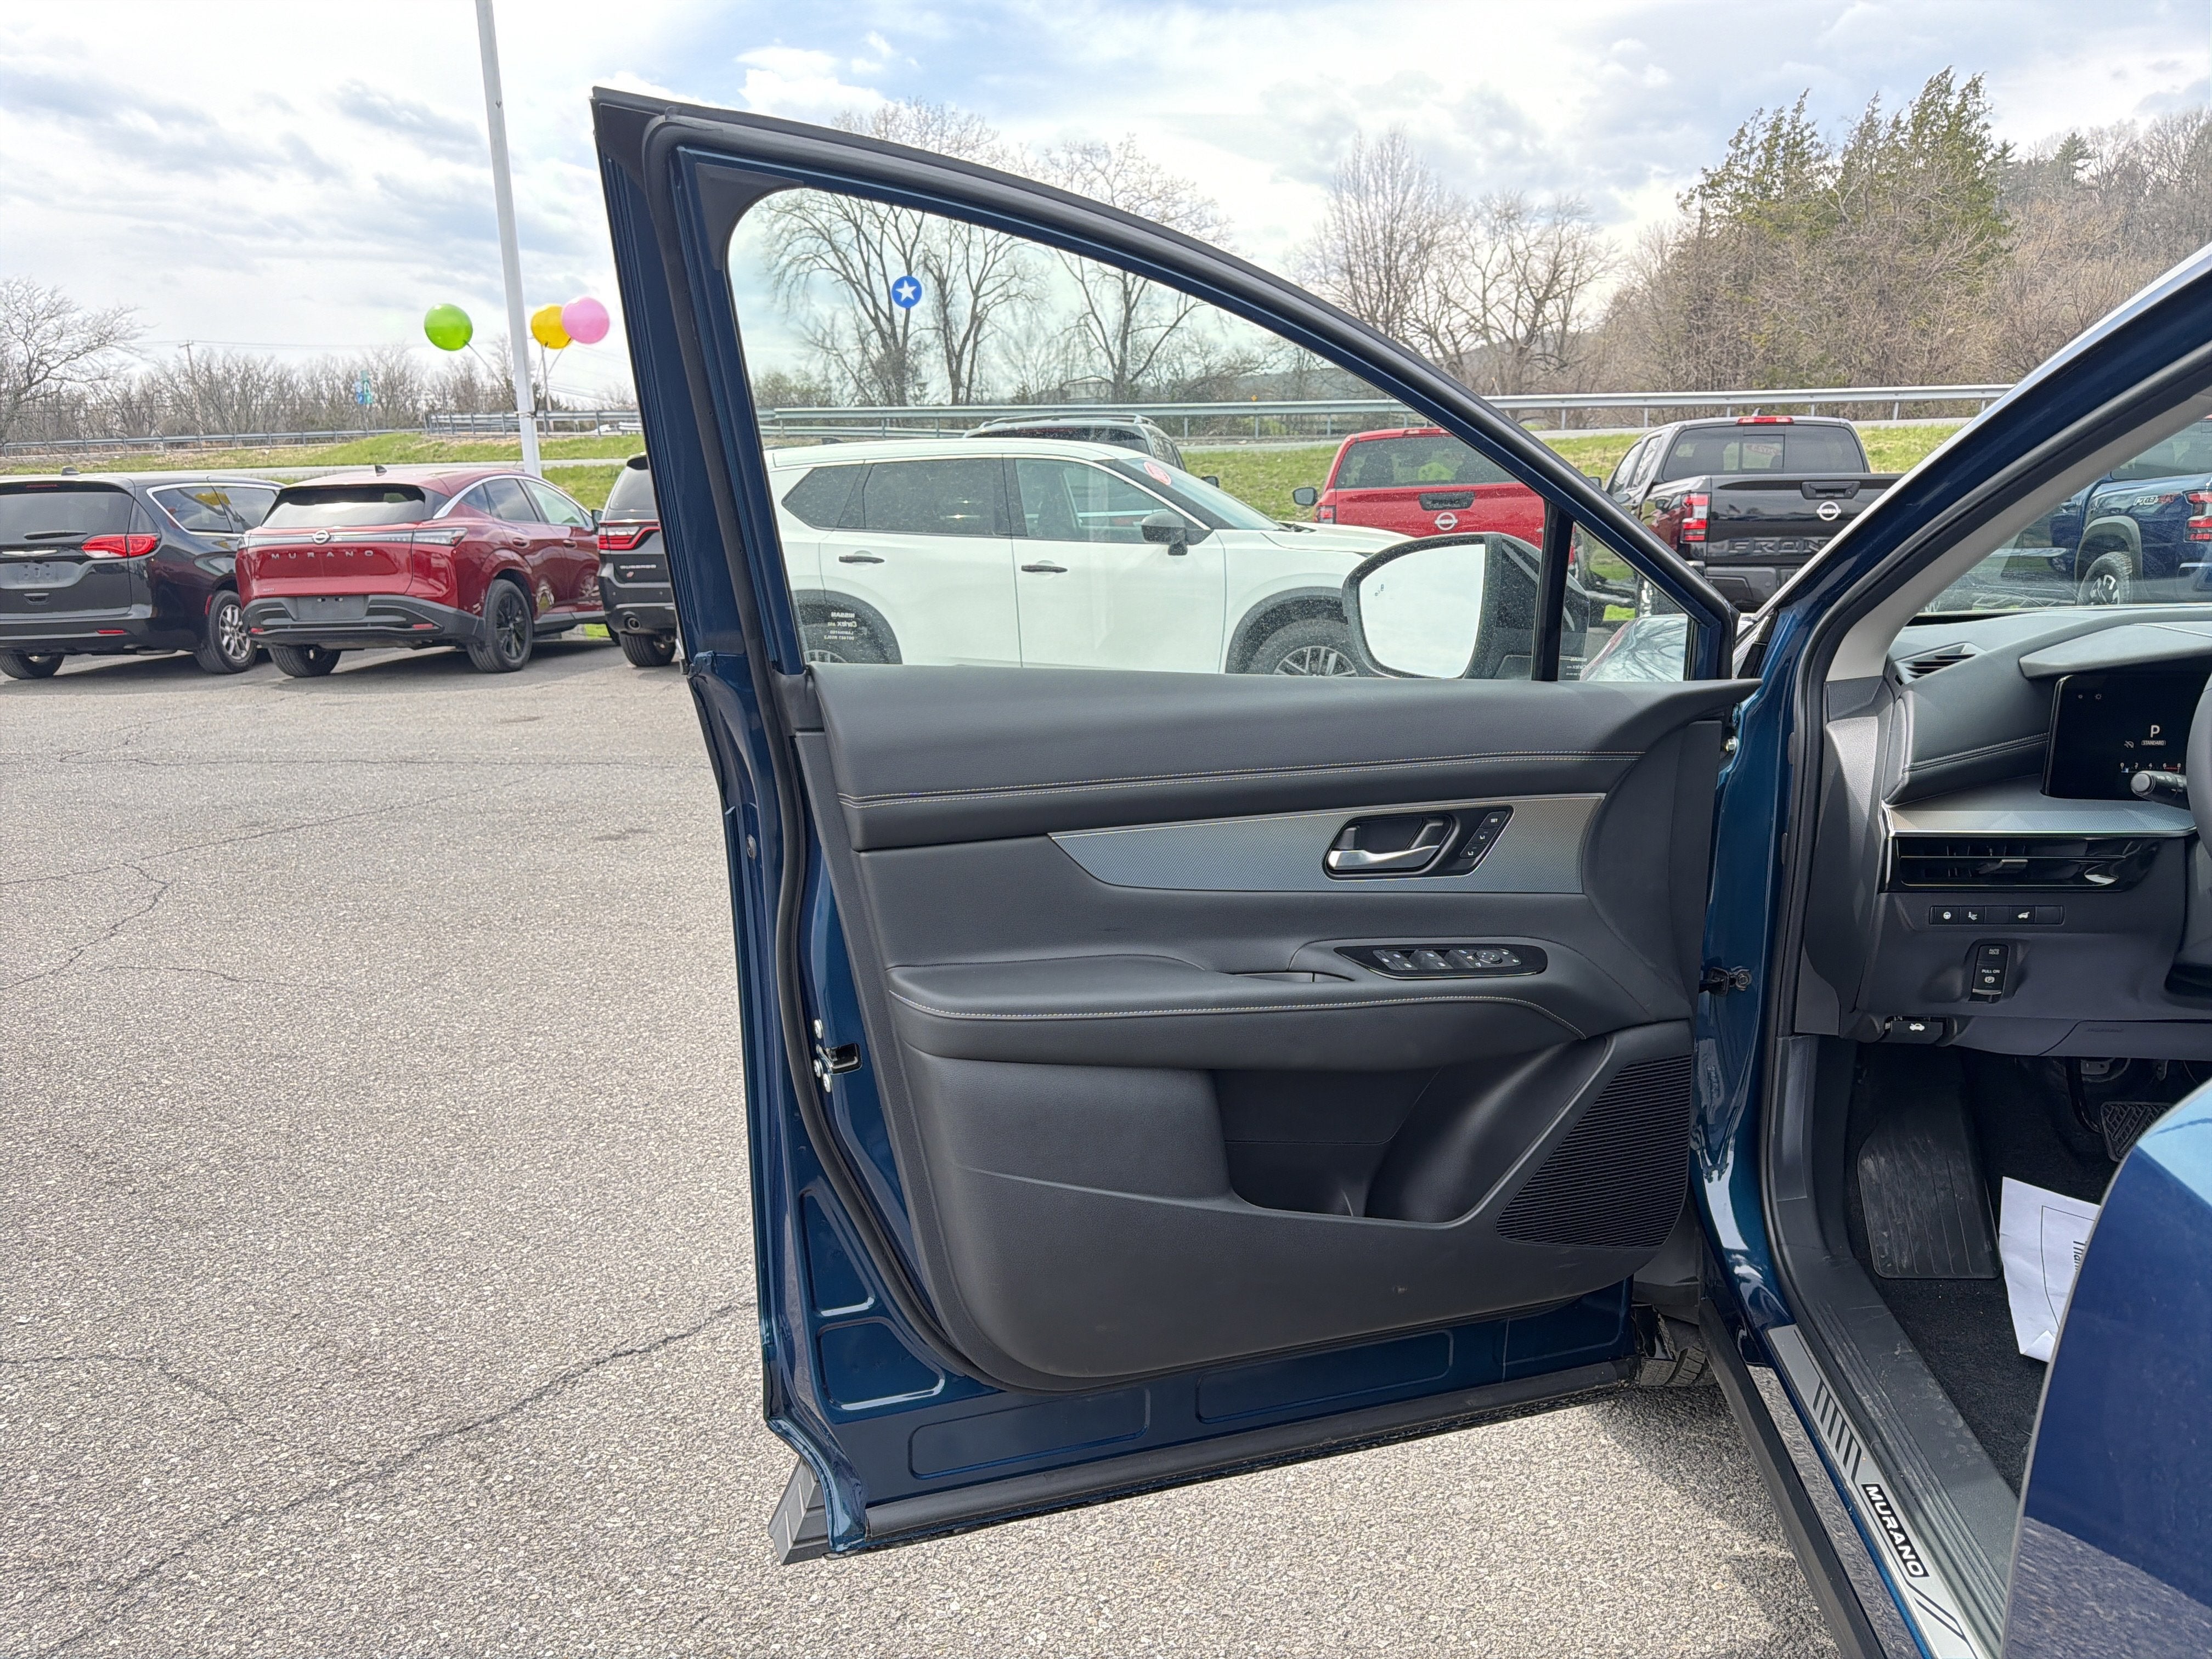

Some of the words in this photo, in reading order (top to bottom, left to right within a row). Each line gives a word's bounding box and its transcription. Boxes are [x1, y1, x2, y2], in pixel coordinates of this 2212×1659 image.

[271, 550, 374, 559] MURANO
[2150, 725, 2160, 738] P
[1866, 1486, 1924, 1576] MURANO
